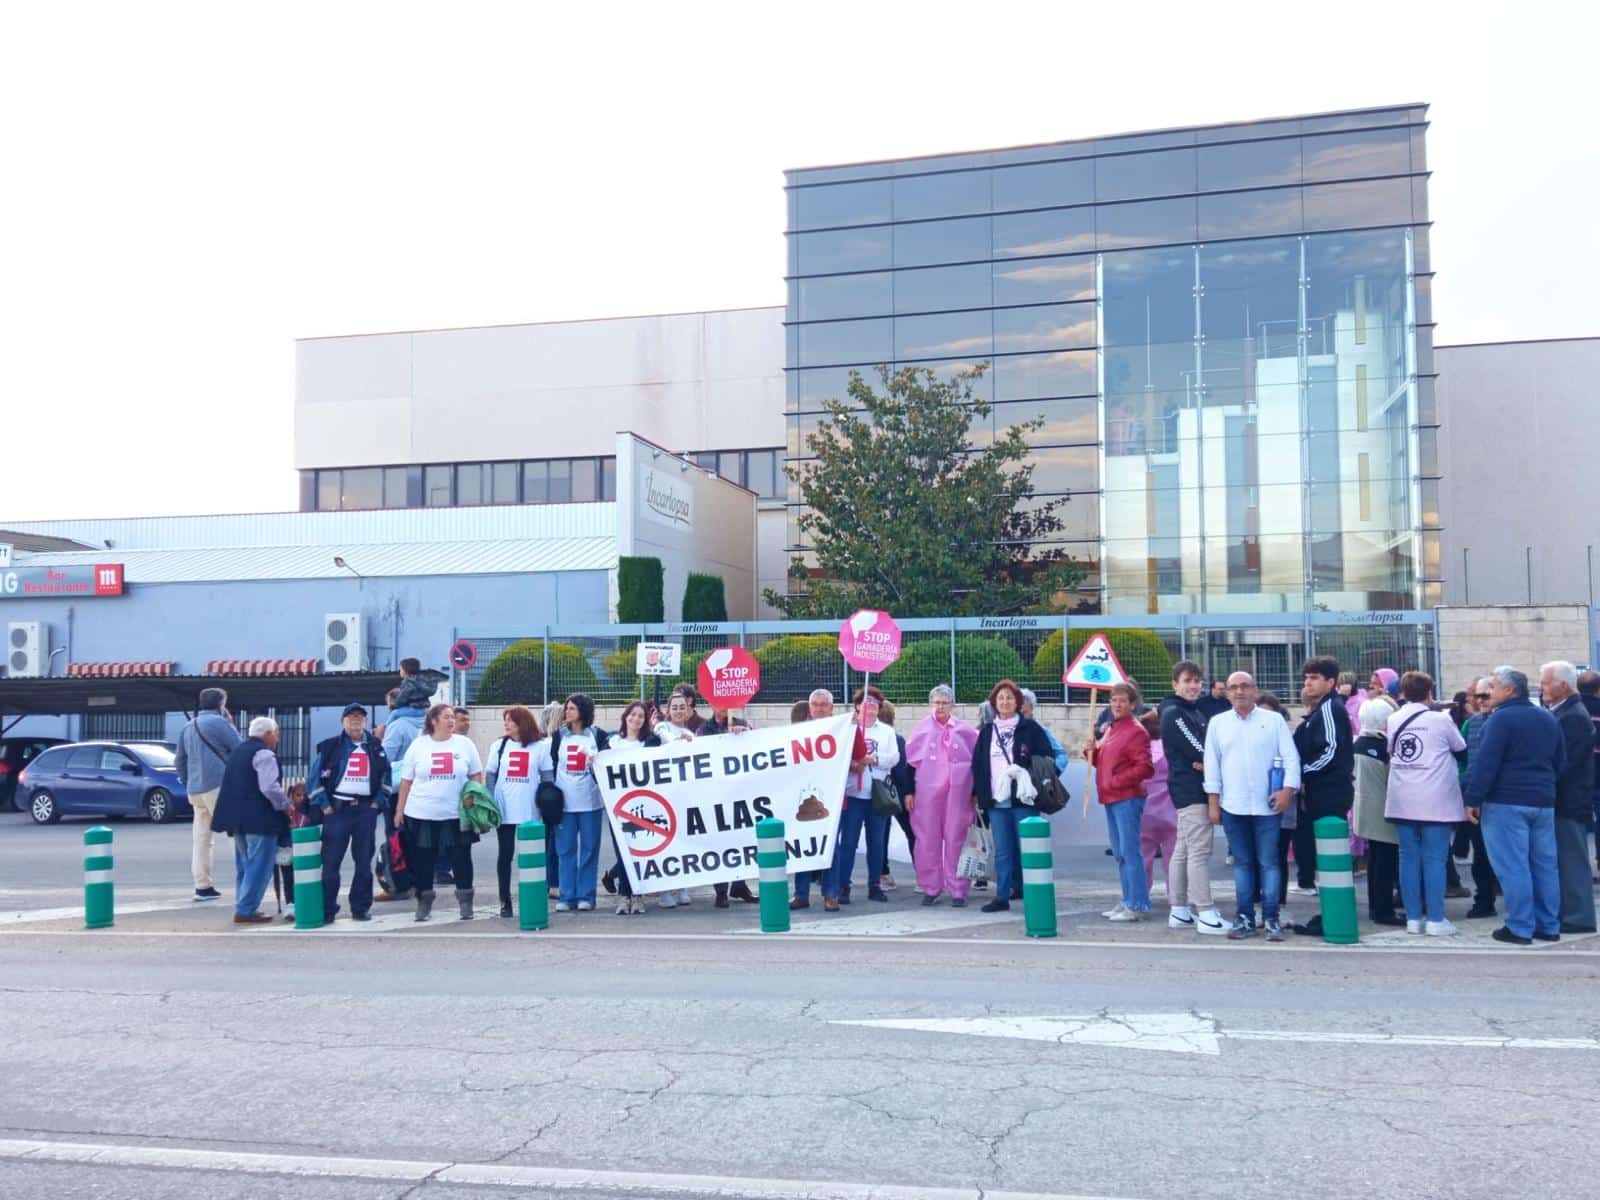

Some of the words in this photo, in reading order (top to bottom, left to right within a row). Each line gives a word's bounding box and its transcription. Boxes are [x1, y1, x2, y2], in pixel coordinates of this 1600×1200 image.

[979, 616, 1038, 629] Incarlopsa
[863, 631, 891, 644] STOP
[721, 667, 749, 679] STOP
[606, 753, 713, 790] HUETE
[723, 748, 787, 775] DICE
[791, 734, 837, 764] NO
[686, 807, 707, 835] A
[714, 796, 774, 832] LAS
[634, 835, 828, 881] ACROGRNJ
